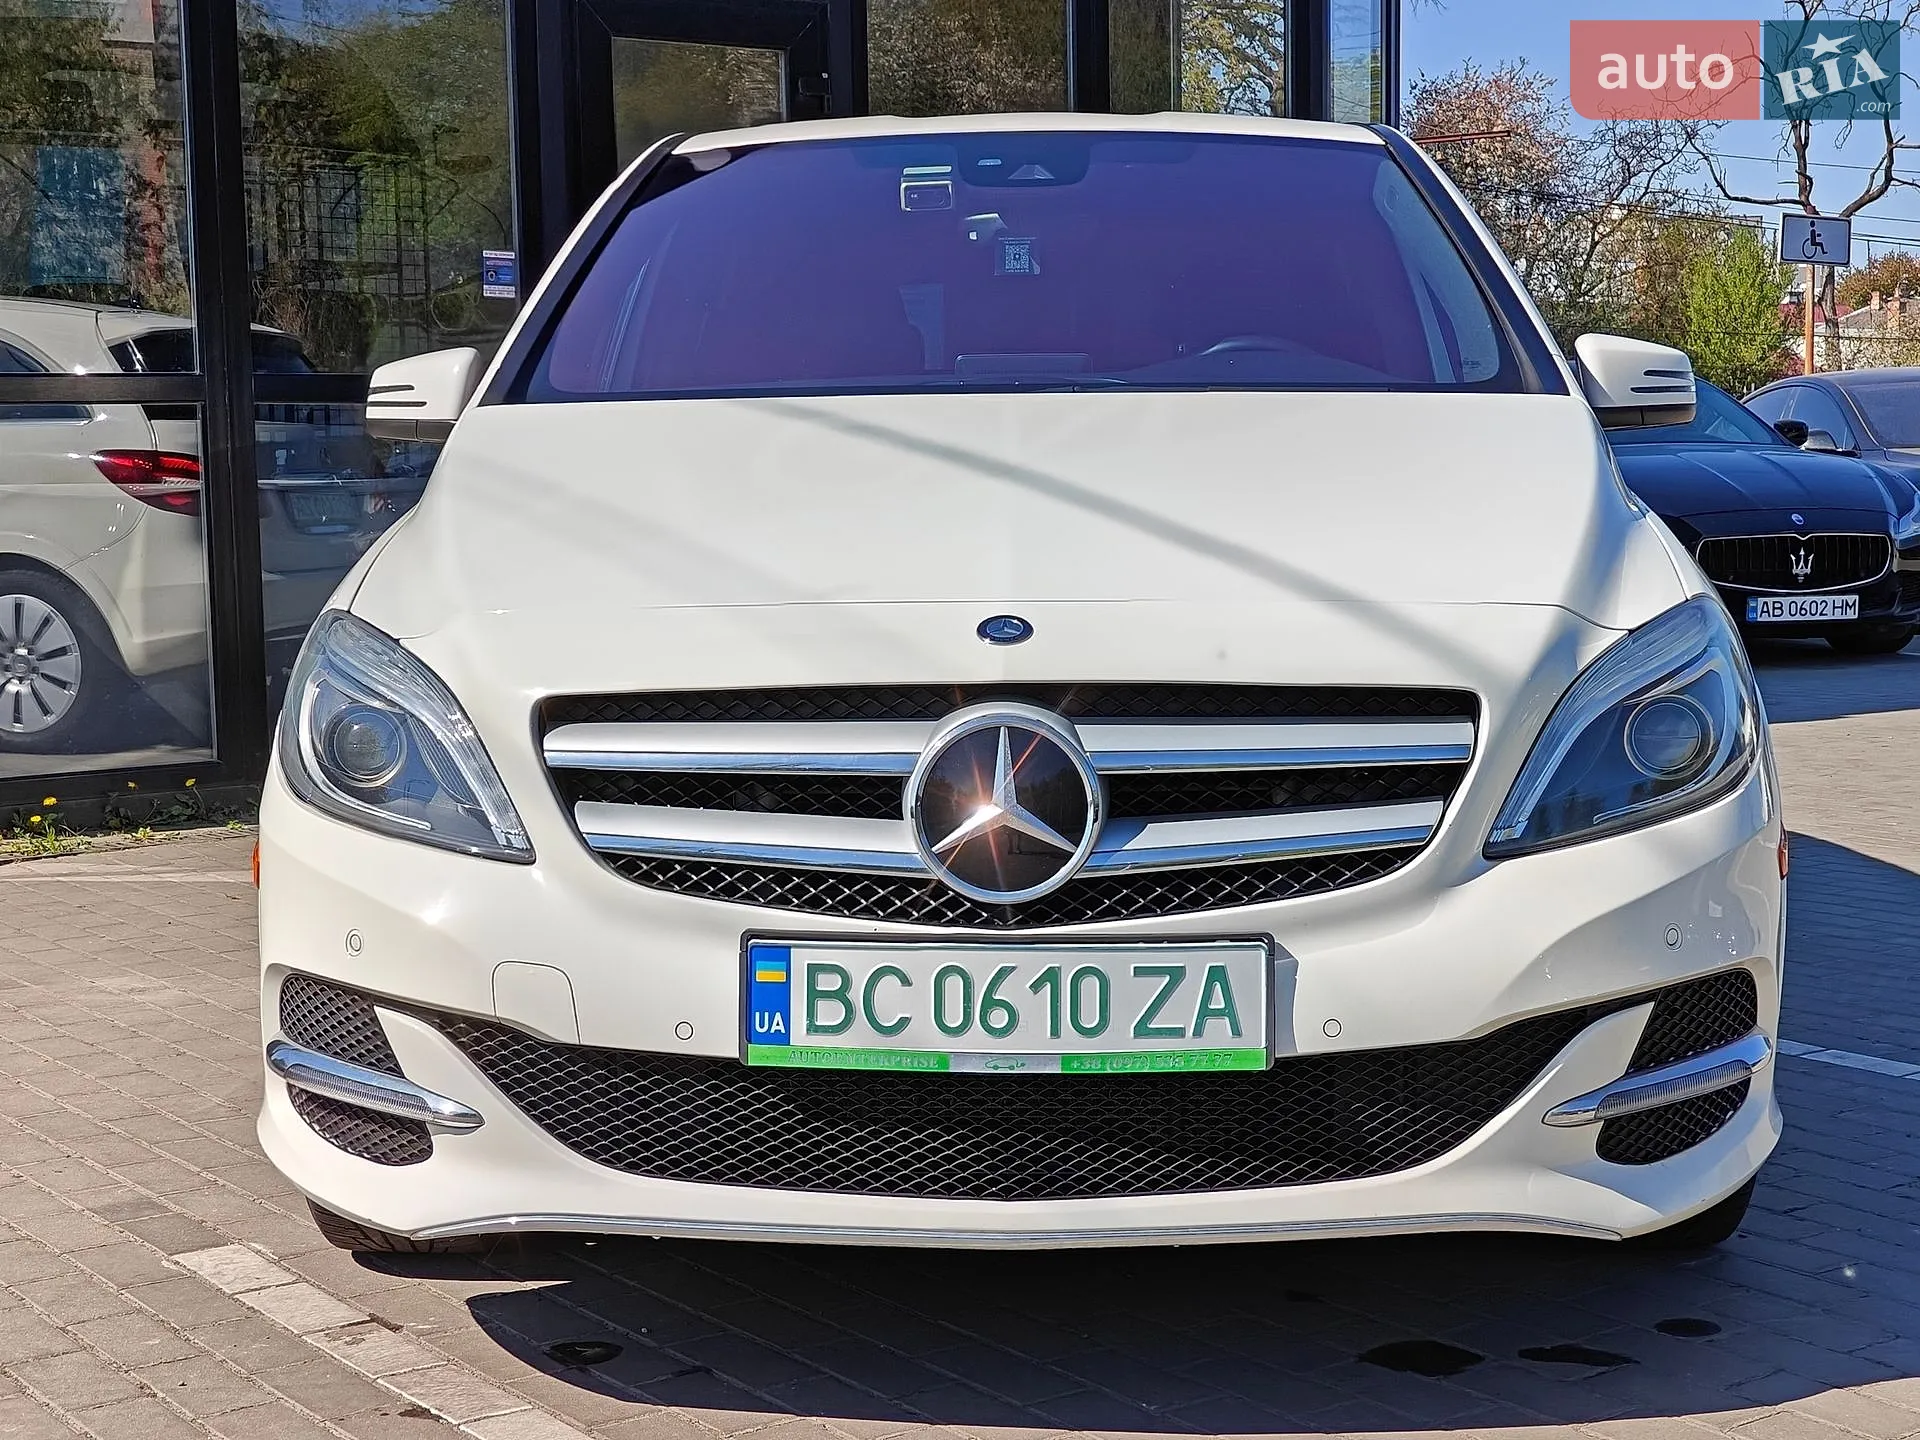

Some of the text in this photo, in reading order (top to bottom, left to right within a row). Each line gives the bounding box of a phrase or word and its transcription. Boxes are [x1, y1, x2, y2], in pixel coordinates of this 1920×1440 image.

[1759, 598, 1857, 618] AB 0602 HM
[804, 962, 1242, 1040] BC 0610 ZA
[755, 1011, 786, 1034] UA
